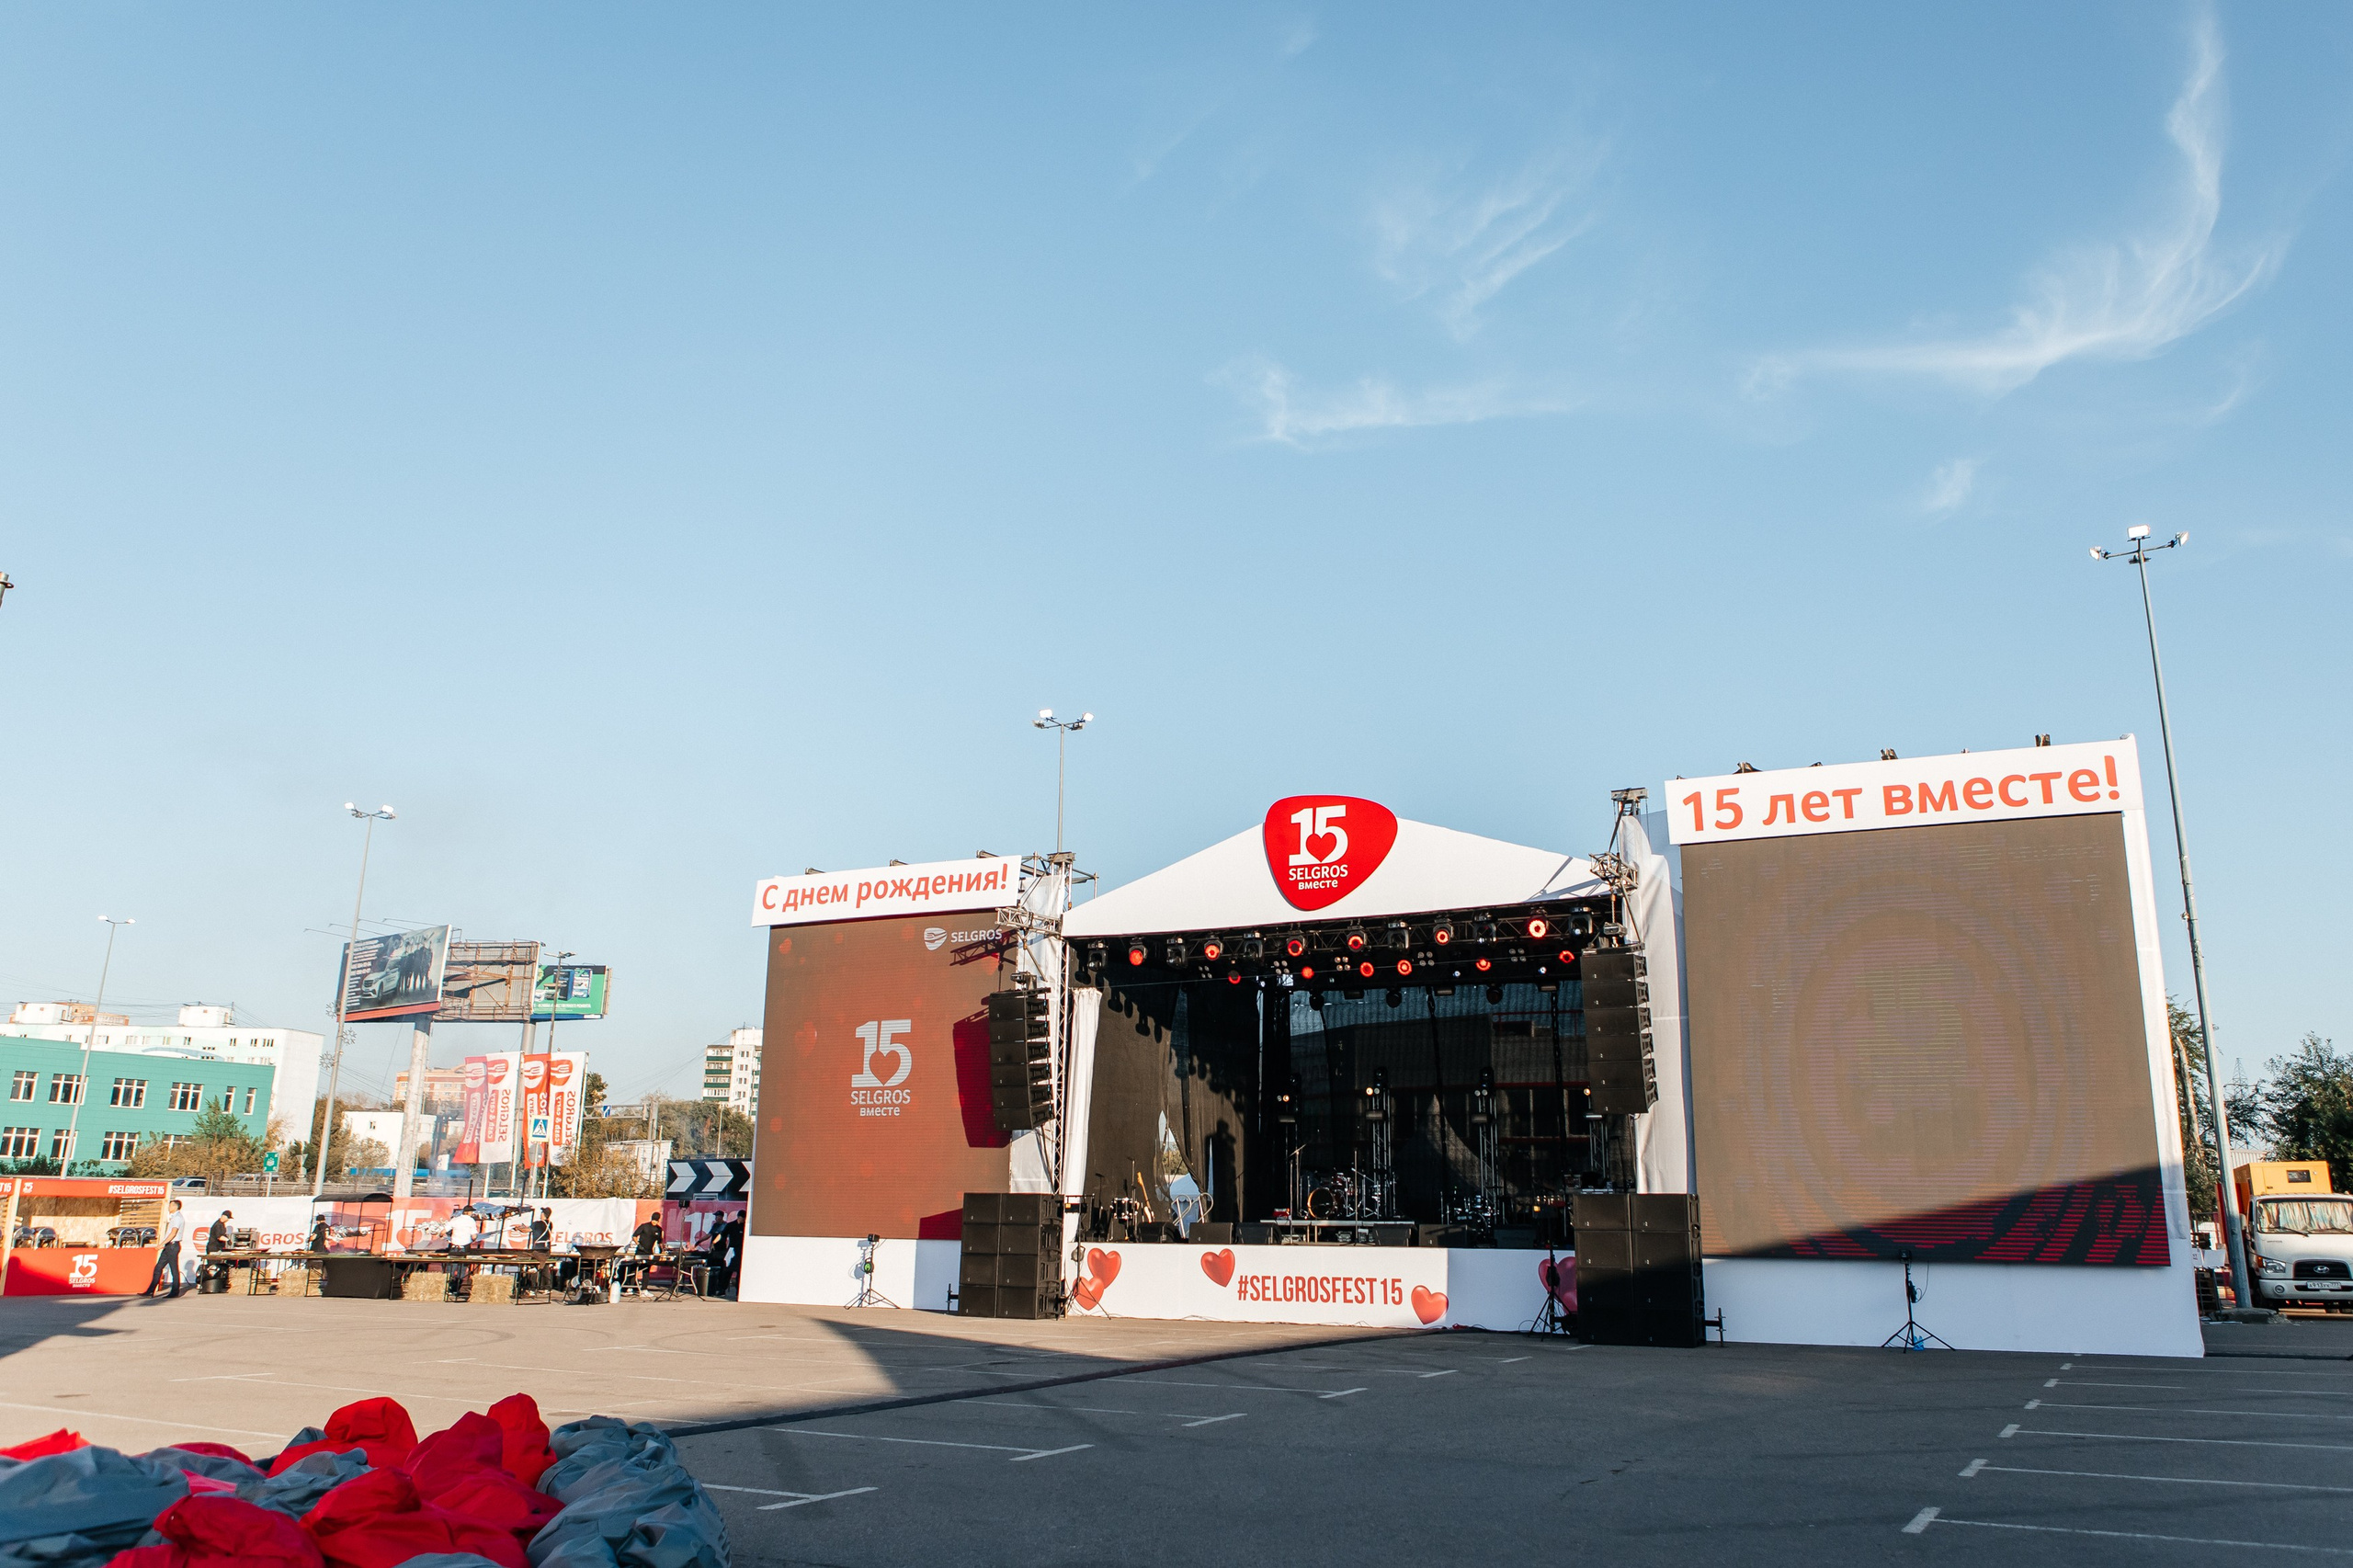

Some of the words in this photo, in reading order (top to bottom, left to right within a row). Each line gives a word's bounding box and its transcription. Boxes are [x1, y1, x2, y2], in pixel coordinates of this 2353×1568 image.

[1682, 787, 1744, 832] 15
[1763, 787, 1863, 826] лет
[1882, 755, 2121, 816] вместе!
[1289, 804, 1348, 867] 15
[1289, 864, 1348, 881] SELGROS
[762, 884, 779, 910] С
[781, 883, 849, 913] днем
[856, 862, 1009, 909] рождения!
[1298, 880, 1338, 890] вместе
[950, 928, 1003, 944] SELGROS
[851, 1018, 913, 1089] 15
[850, 1089, 911, 1106] SELGROS
[859, 1106, 901, 1117] вместе
[108, 1185, 165, 1195] #SELGROSFEST15
[260, 1233, 305, 1245] GROS
[69, 1254, 98, 1278] 15
[1237, 1275, 1404, 1306] #SELGROSFEST15
